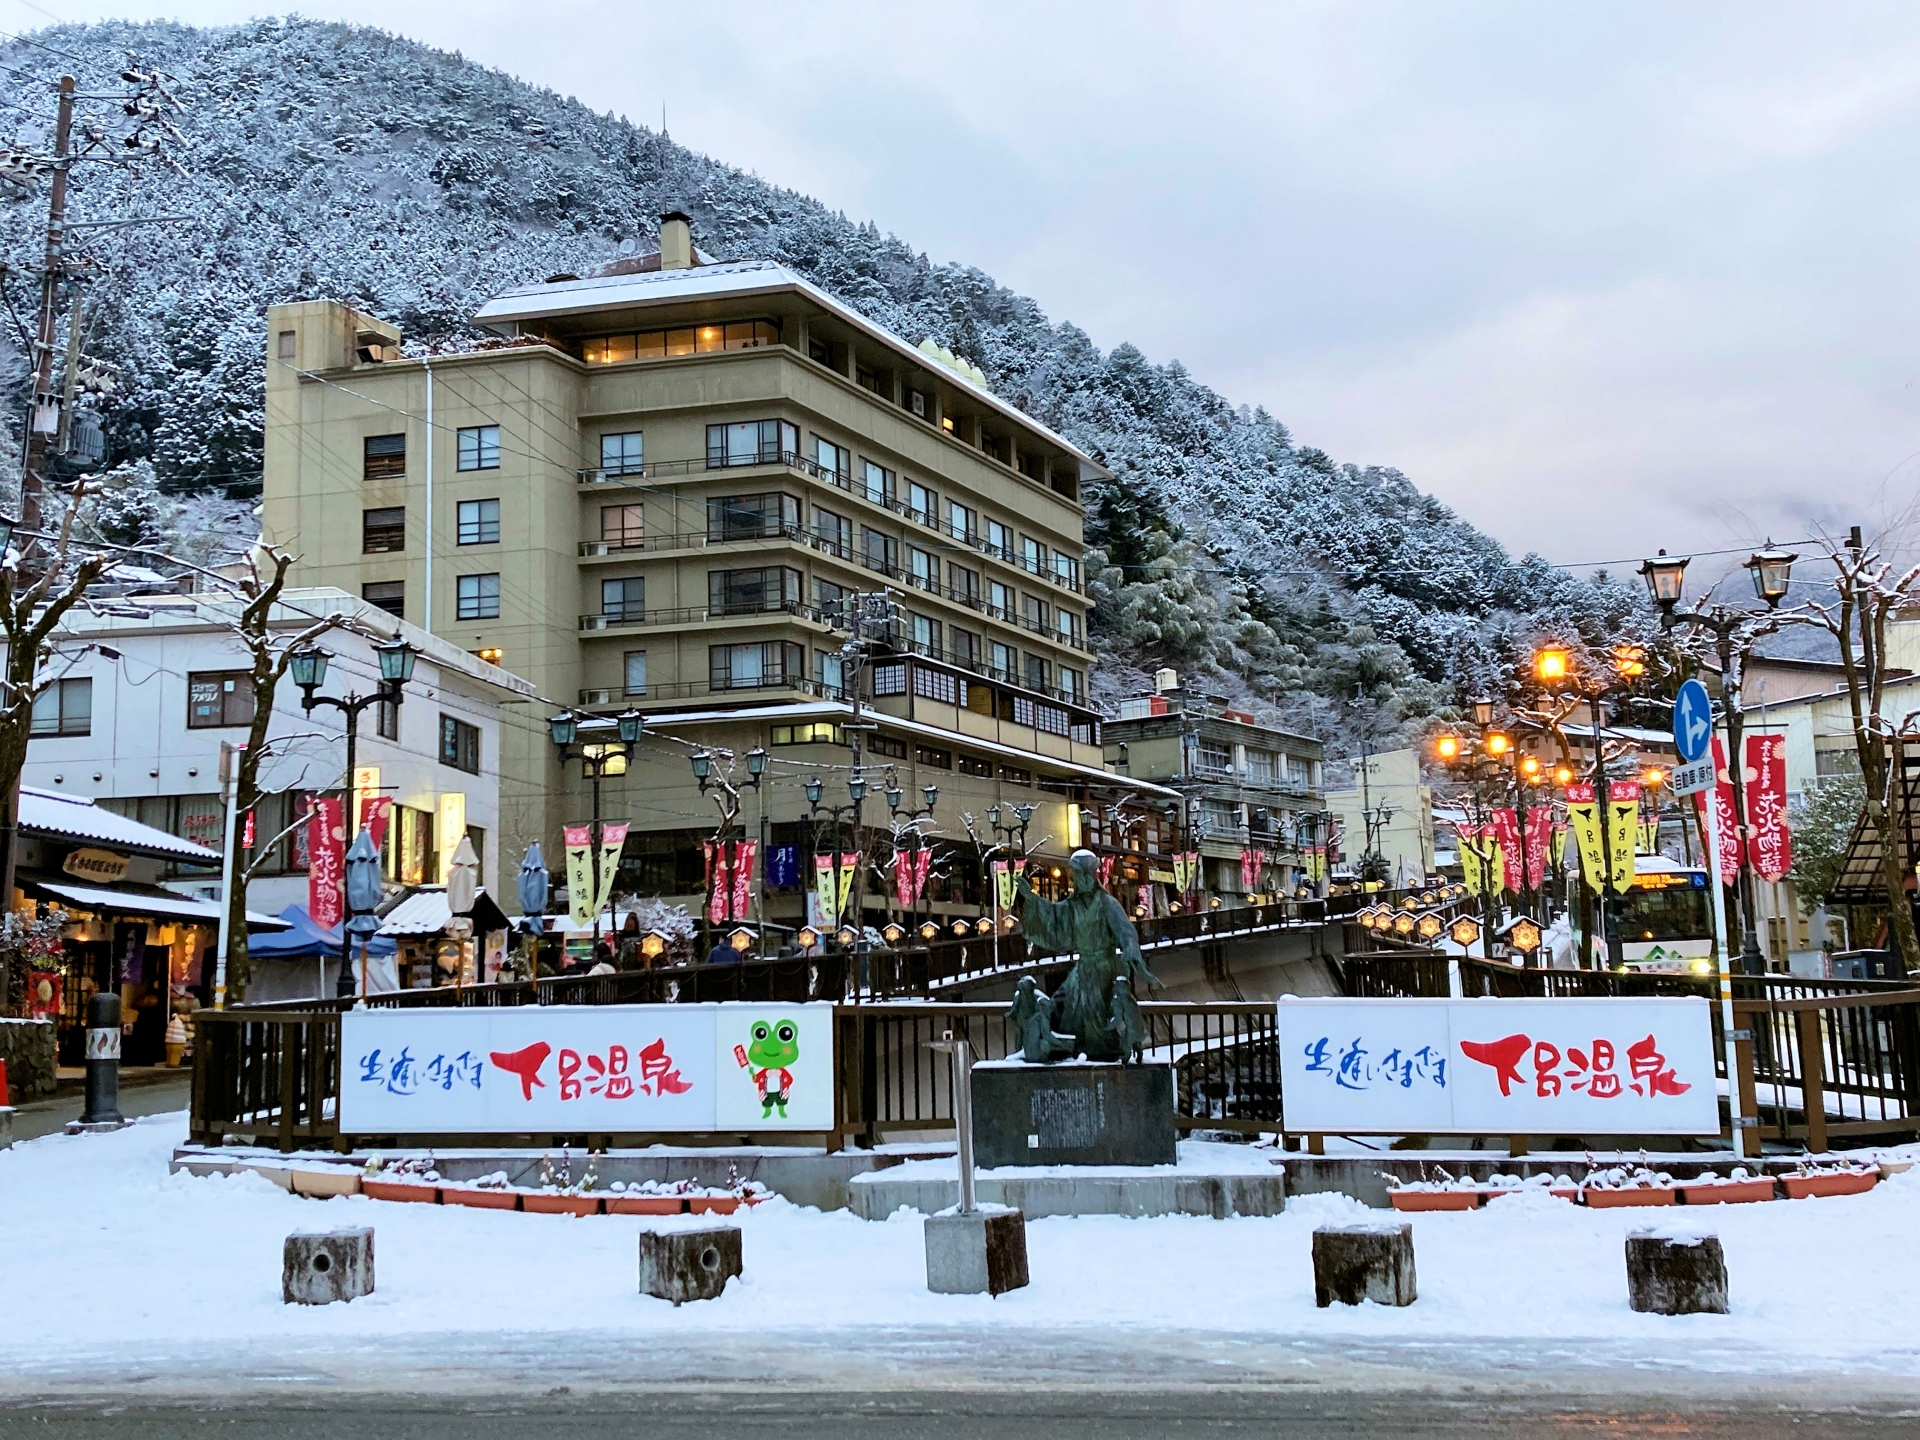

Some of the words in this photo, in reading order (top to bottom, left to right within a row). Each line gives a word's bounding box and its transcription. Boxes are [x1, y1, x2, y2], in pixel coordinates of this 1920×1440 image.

[1568, 787, 1593, 801] 歓迎
[1675, 763, 1713, 791] 自動車・原付
[315, 846, 339, 923] 花火物語
[490, 1039, 693, 1101] 下呂温泉
[1460, 1033, 1692, 1098] 下呂温泉
